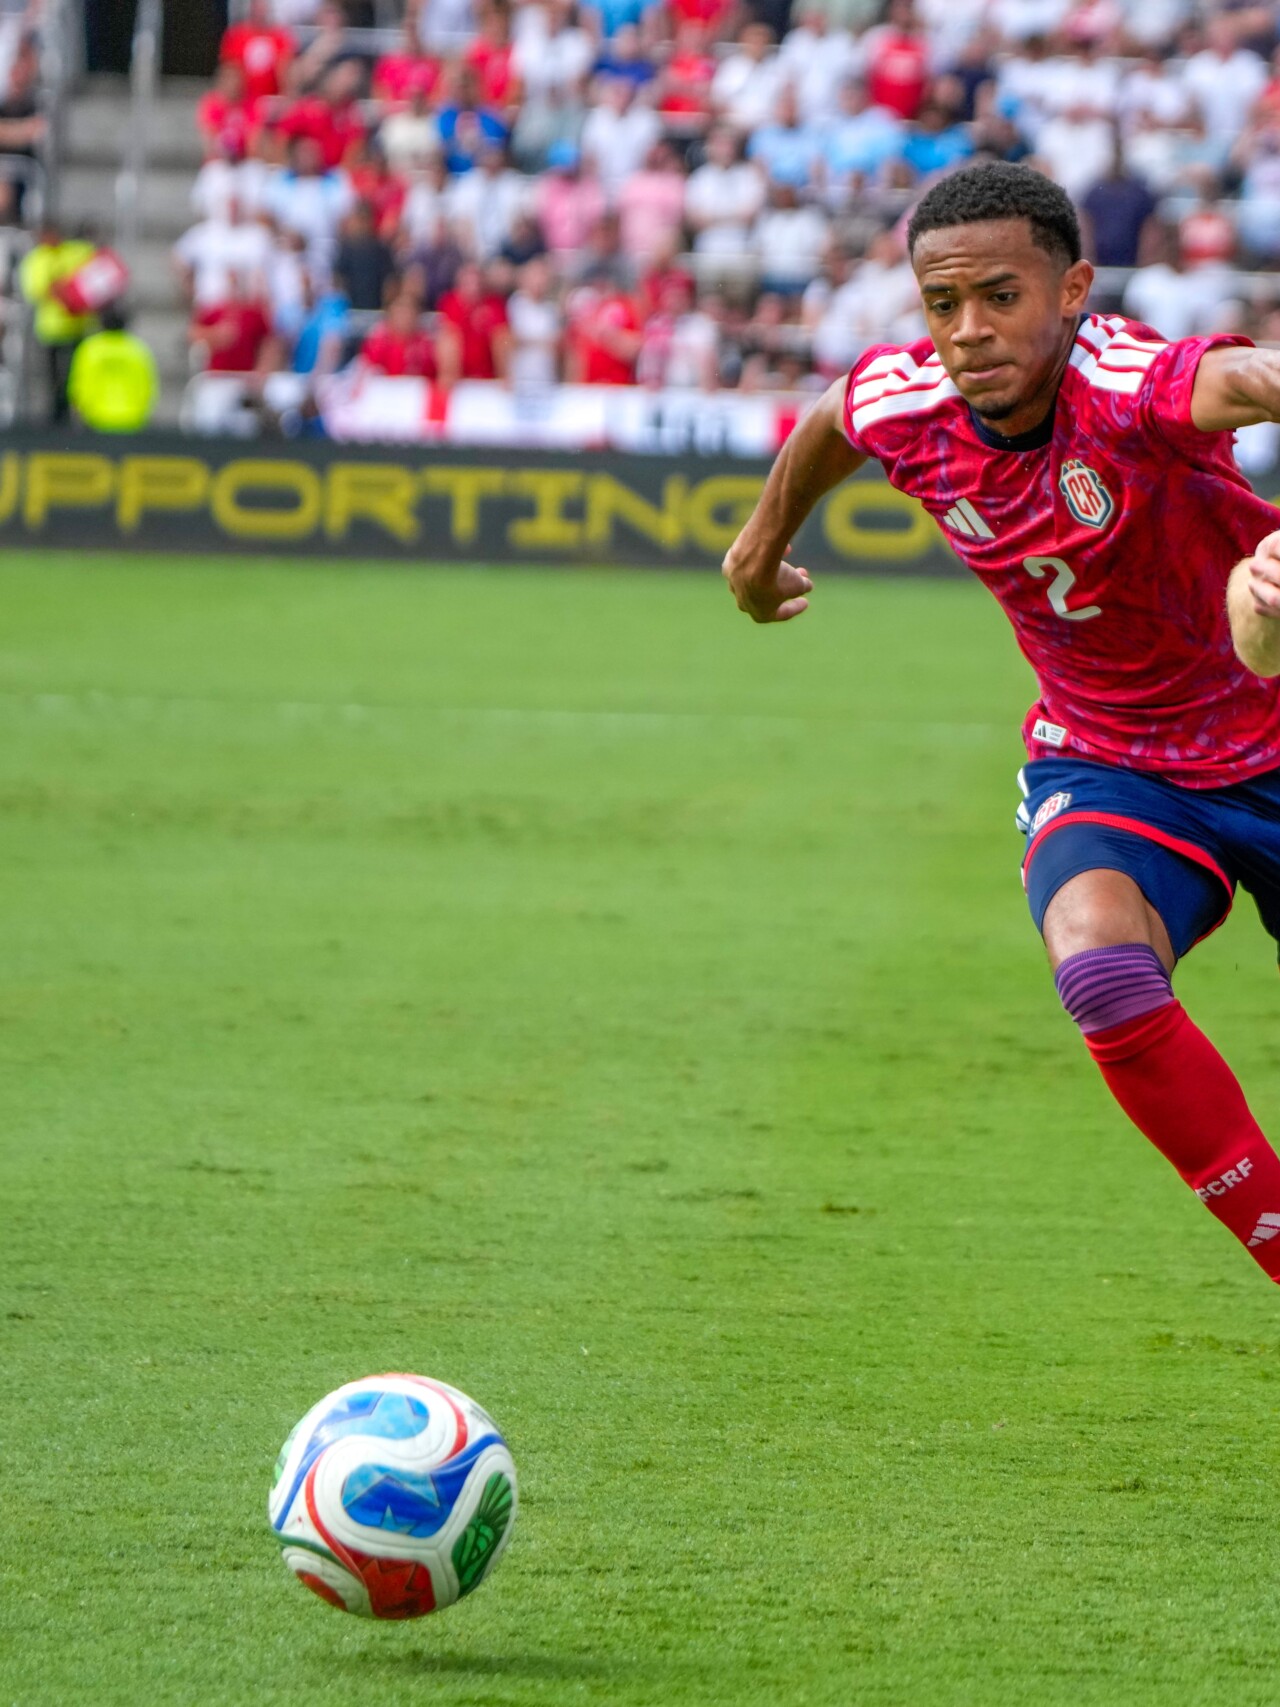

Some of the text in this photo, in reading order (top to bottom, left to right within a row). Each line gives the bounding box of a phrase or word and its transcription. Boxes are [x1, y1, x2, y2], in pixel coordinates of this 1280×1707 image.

[0, 451, 766, 556] PPORTING
[1066, 472, 1102, 517] CR
[1022, 555, 1102, 621] 2
[1195, 1156, 1254, 1203] FCRF
